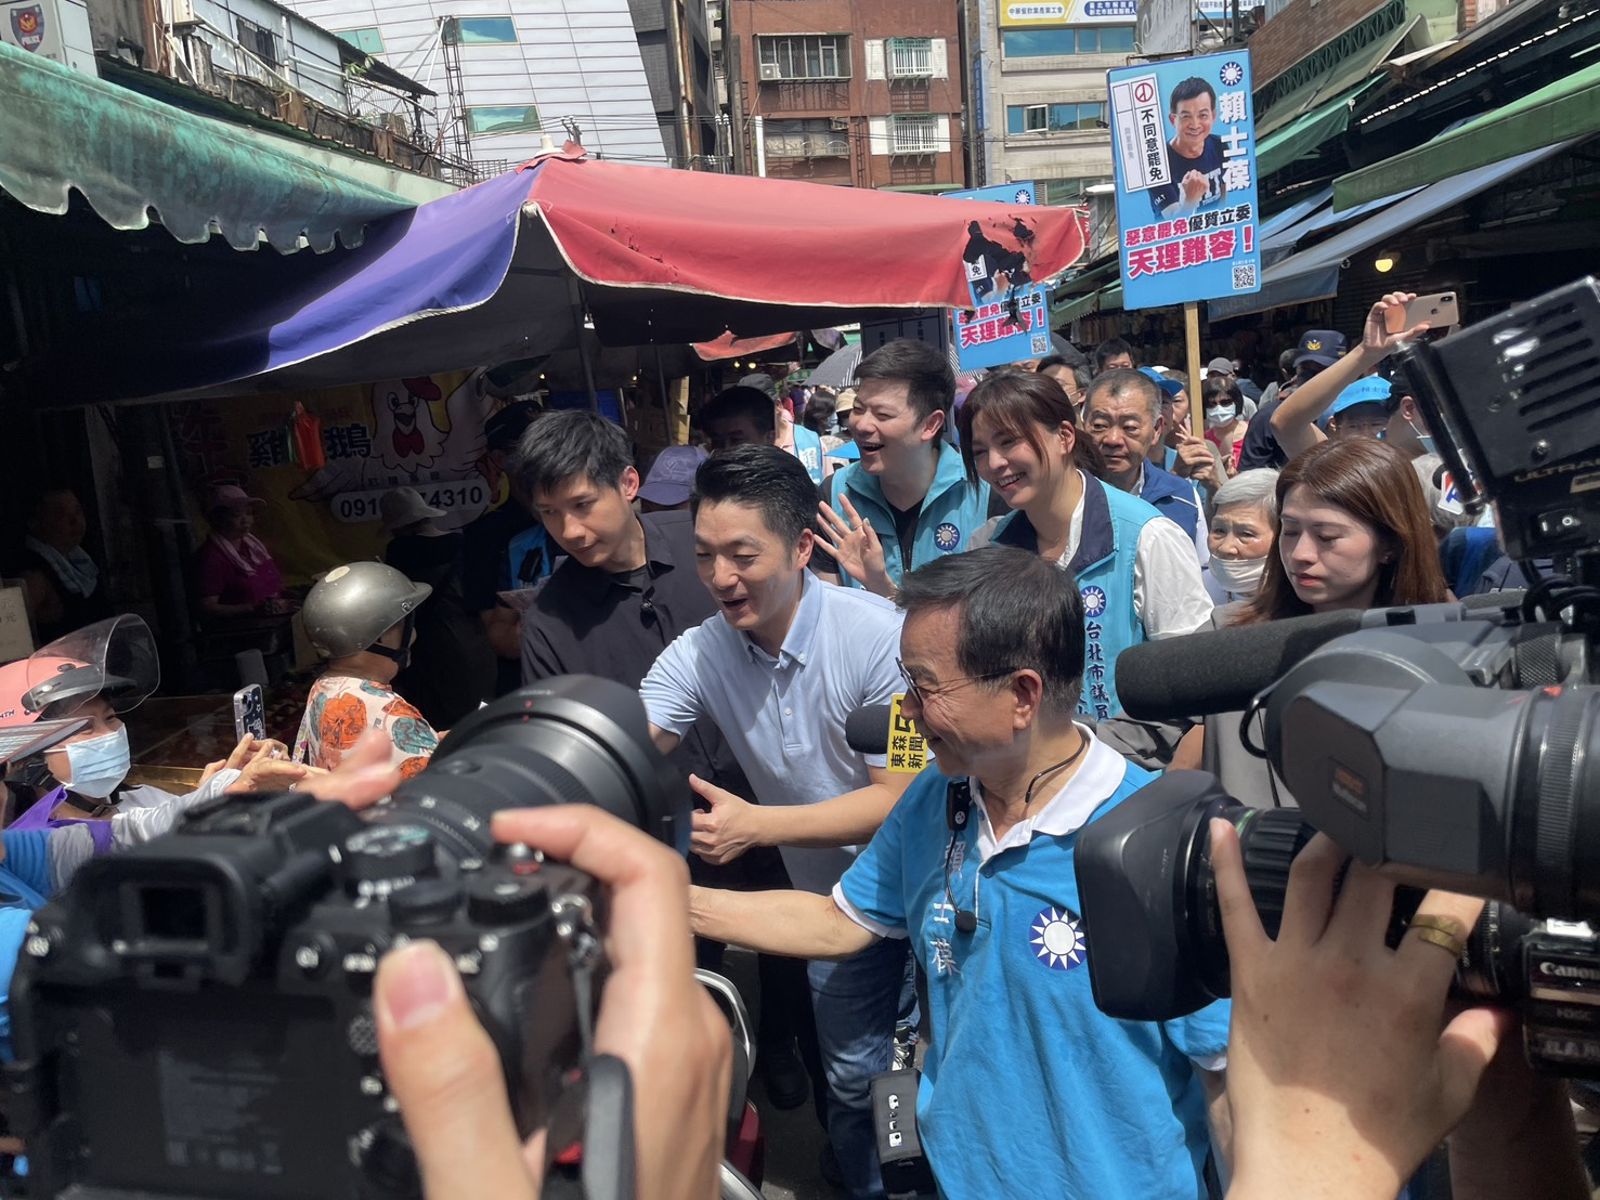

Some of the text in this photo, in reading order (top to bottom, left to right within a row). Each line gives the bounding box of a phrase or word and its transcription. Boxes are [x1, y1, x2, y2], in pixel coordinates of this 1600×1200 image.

[1140, 108, 1164, 182] 不同意罷免
[1219, 91, 1251, 192] 賴士葆
[1125, 203, 1251, 246] 惡意罷免優質立委
[1087, 621, 1111, 720] 台北市議員
[891, 735, 908, 768] 東森
